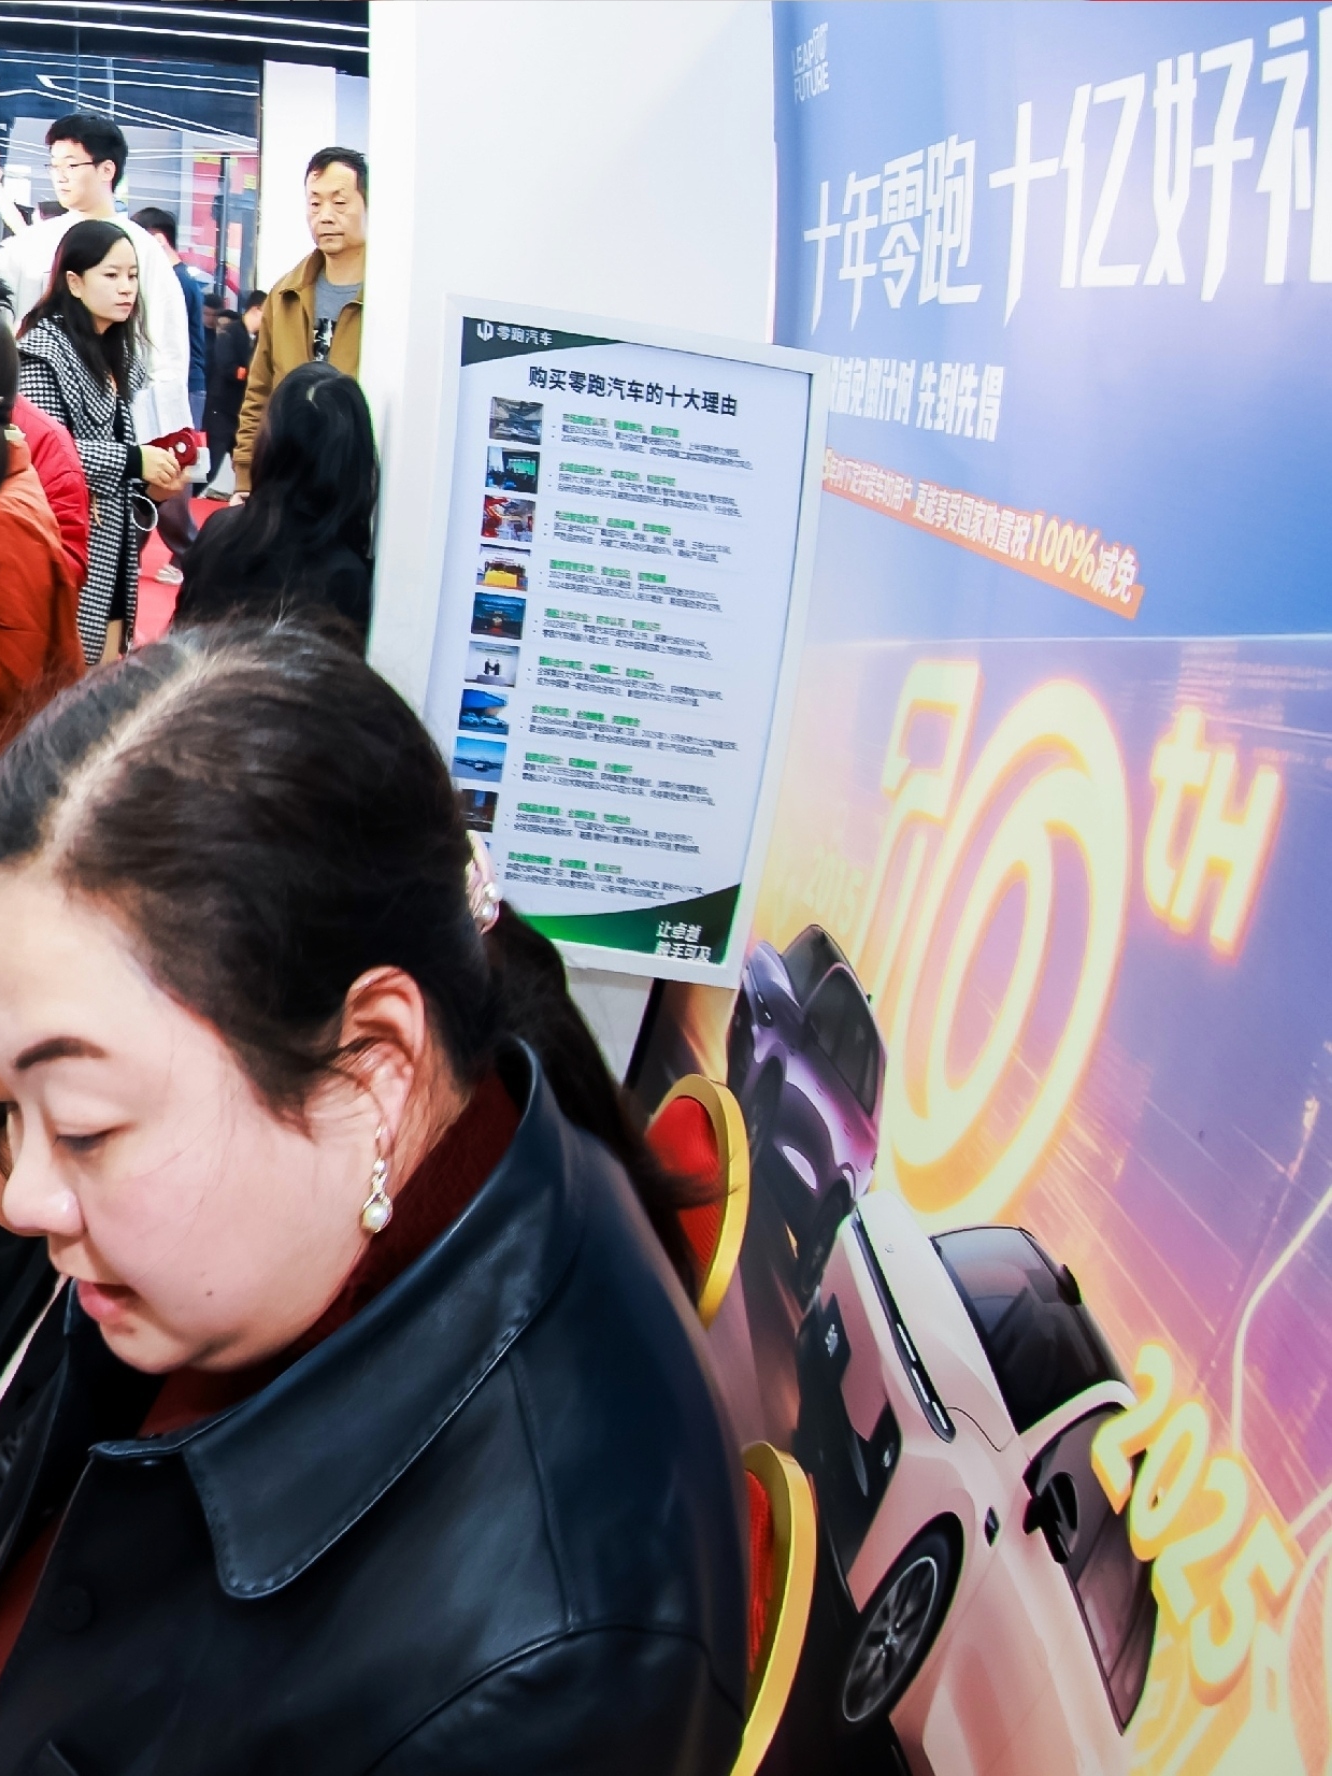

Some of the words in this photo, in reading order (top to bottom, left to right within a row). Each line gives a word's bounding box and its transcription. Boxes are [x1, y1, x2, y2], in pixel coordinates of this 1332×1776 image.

[793, 64, 830, 104] FUTURE
[804, 134, 983, 336] 十年零跑
[496, 324, 554, 346] 零跑汽车
[528, 366, 739, 417] 购买零跑汽车的十大理由
[915, 361, 1006, 442] 先到先得
[1091, 1343, 1294, 1702] 2025
